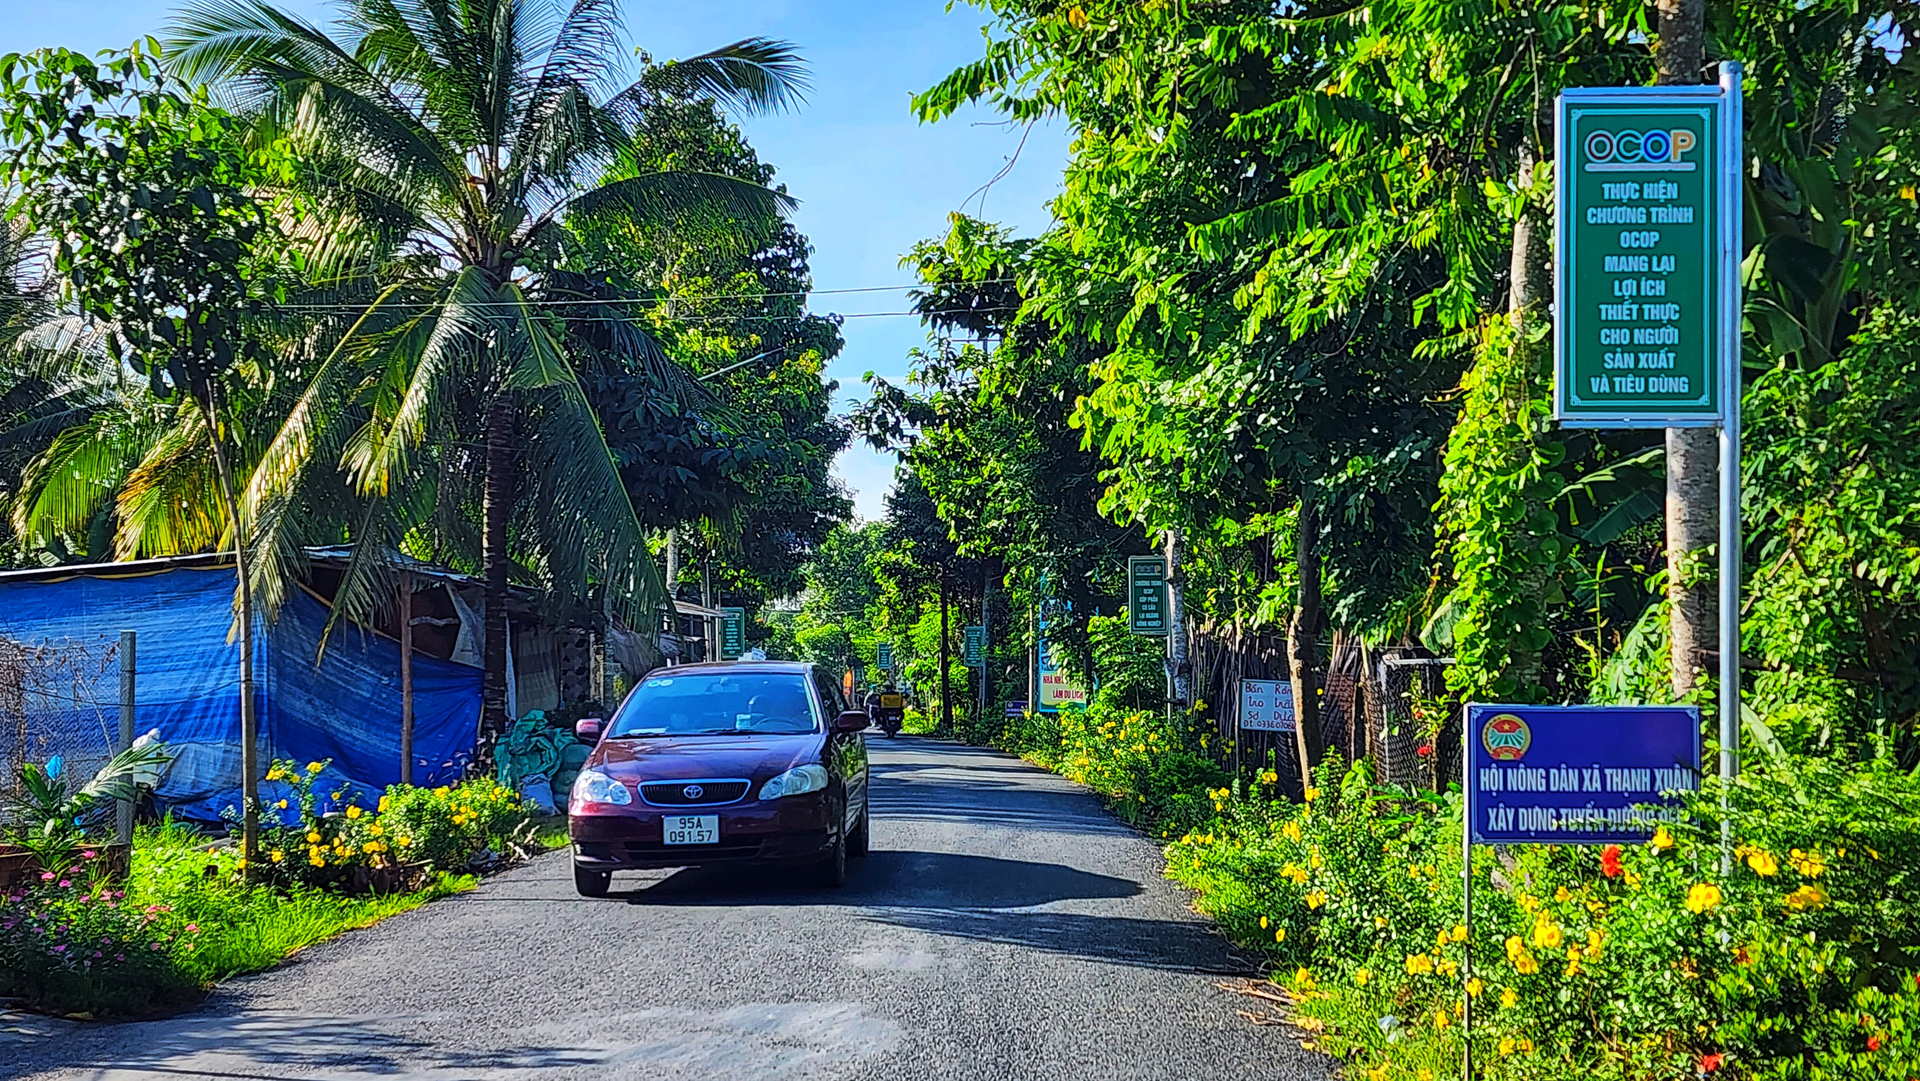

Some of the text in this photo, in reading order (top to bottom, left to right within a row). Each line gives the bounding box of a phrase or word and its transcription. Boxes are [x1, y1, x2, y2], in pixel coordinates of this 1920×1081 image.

[1584, 129, 1696, 163] OCOP
[1601, 179, 1678, 203] THỰC HIỆN
[1586, 203, 1694, 224] CHƯƠNG TRÌNH
[1620, 231, 1660, 248] OCOP
[1604, 255, 1676, 275] MANG LẠI
[1613, 276, 1666, 299] LỢI ÍCH
[1598, 299, 1680, 324] THIẾT THỰC
[1600, 324, 1679, 345] CHO NGƯỜI
[1603, 346, 1677, 369] SẢN XUẤT
[1590, 373, 1689, 393] VÀ TIÊU DÙNG
[1245, 681, 1264, 694] Bán
[1249, 695, 1264, 708] tro
[1480, 763, 1693, 798] HỘI NÔNG DÂN XÃ THẠNH XUÂN
[679, 817, 703, 830] 95A
[1487, 802, 1515, 832] XÂY
[1518, 805, 1557, 837] DỰNG
[1559, 801, 1604, 832] TUYẾN
[670, 829, 713, 843] 091.57
